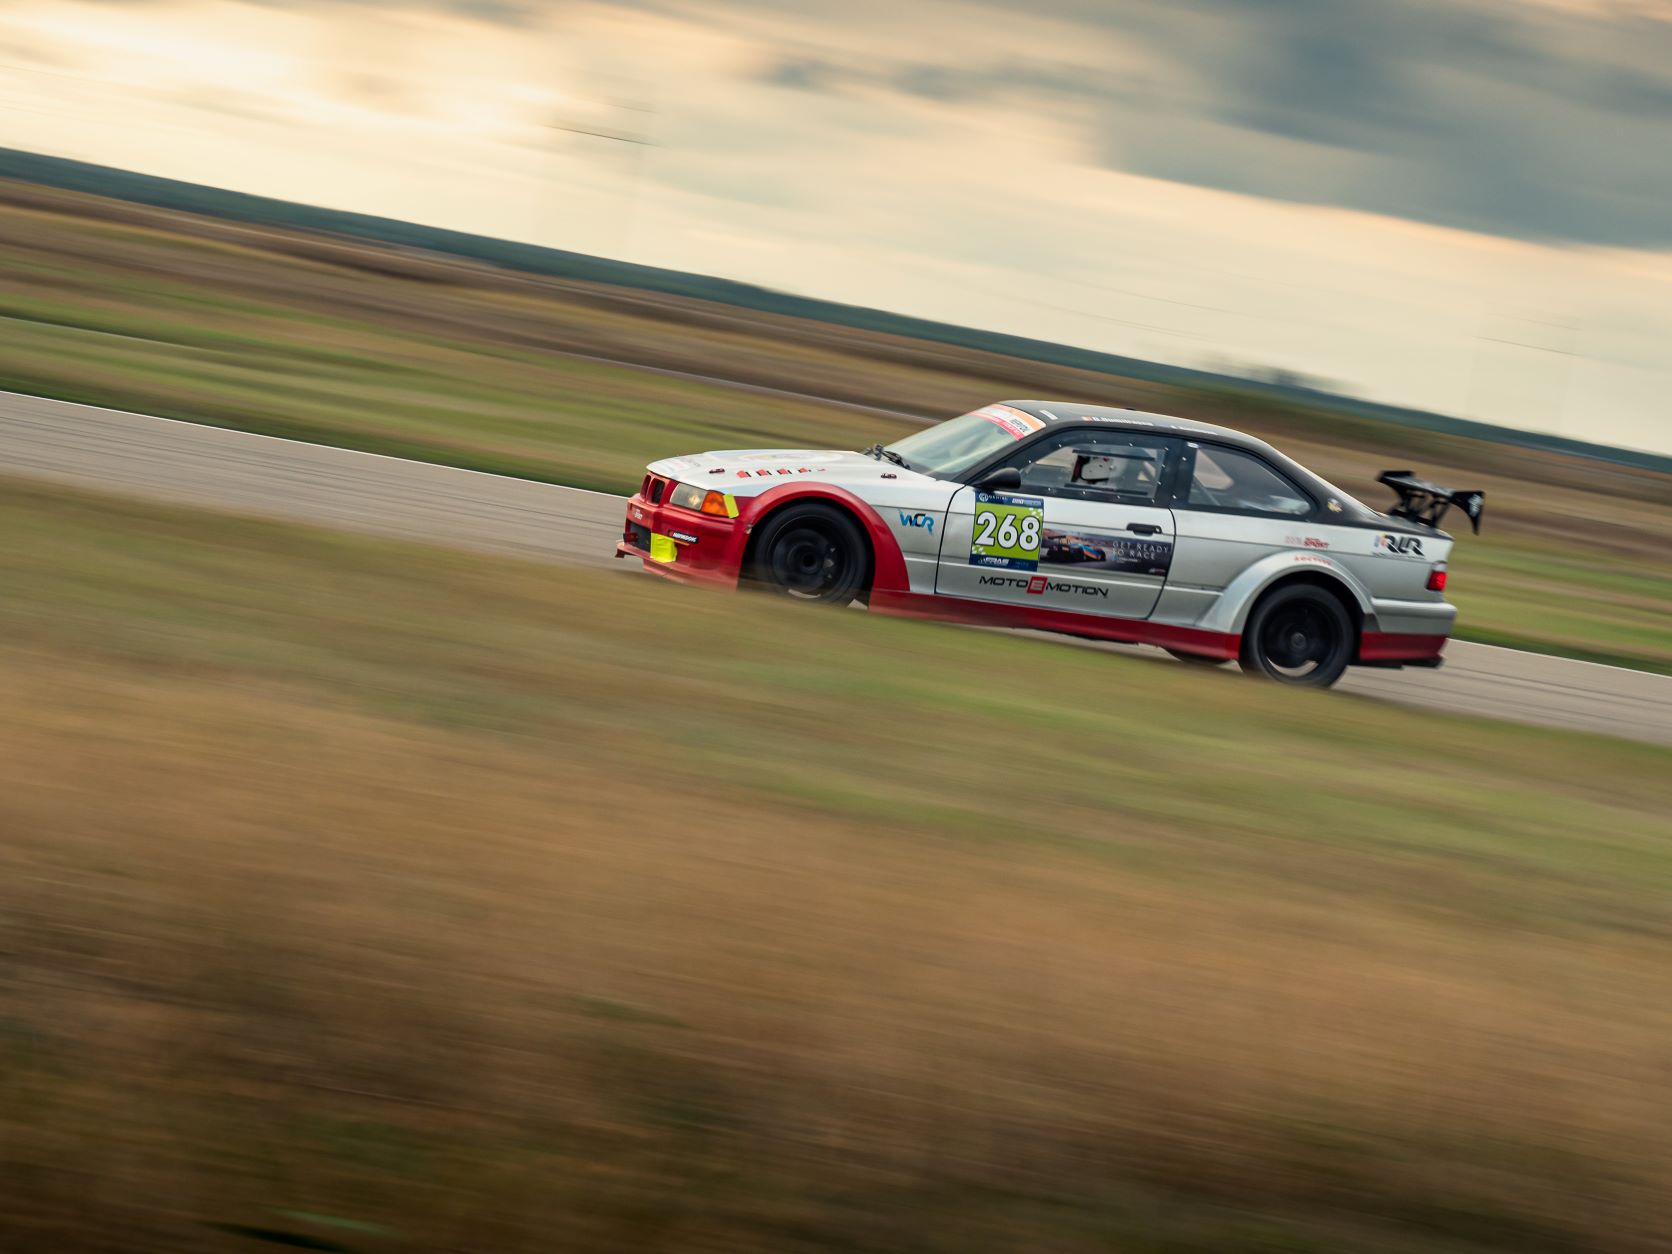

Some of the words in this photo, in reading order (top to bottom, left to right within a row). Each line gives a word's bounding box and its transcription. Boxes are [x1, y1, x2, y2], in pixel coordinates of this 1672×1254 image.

[974, 511, 1040, 551] 268
[1112, 540, 1132, 550] GET
[1136, 542, 1169, 554] READY
[1129, 549, 1156, 560] RACE
